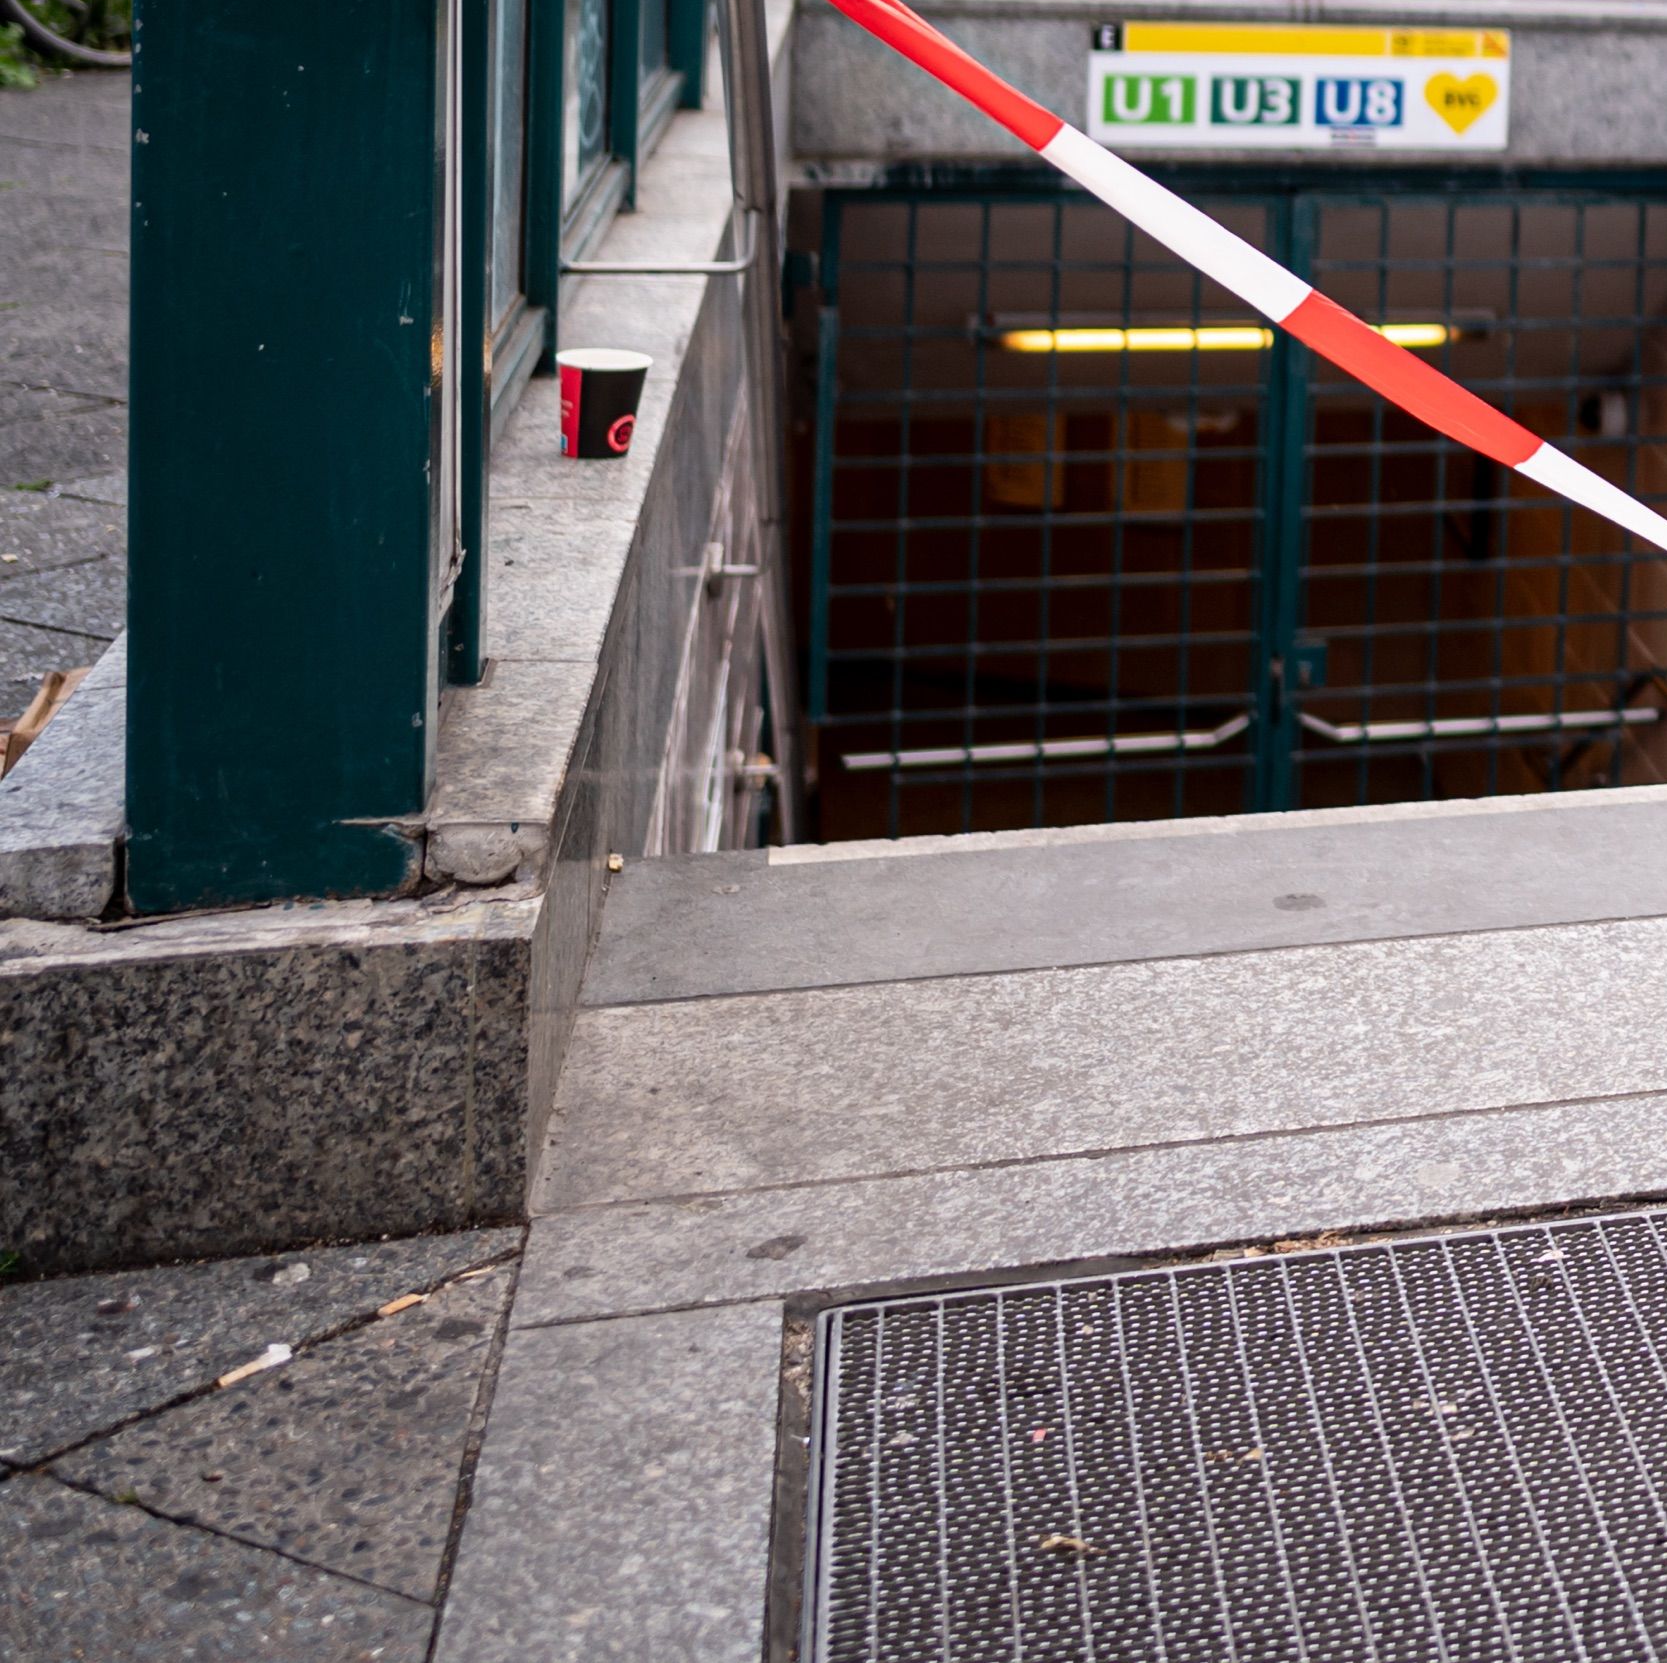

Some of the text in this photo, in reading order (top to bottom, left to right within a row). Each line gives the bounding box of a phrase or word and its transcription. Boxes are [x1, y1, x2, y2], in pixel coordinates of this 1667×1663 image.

[1113, 77, 1398, 125] U1 U3 U8
